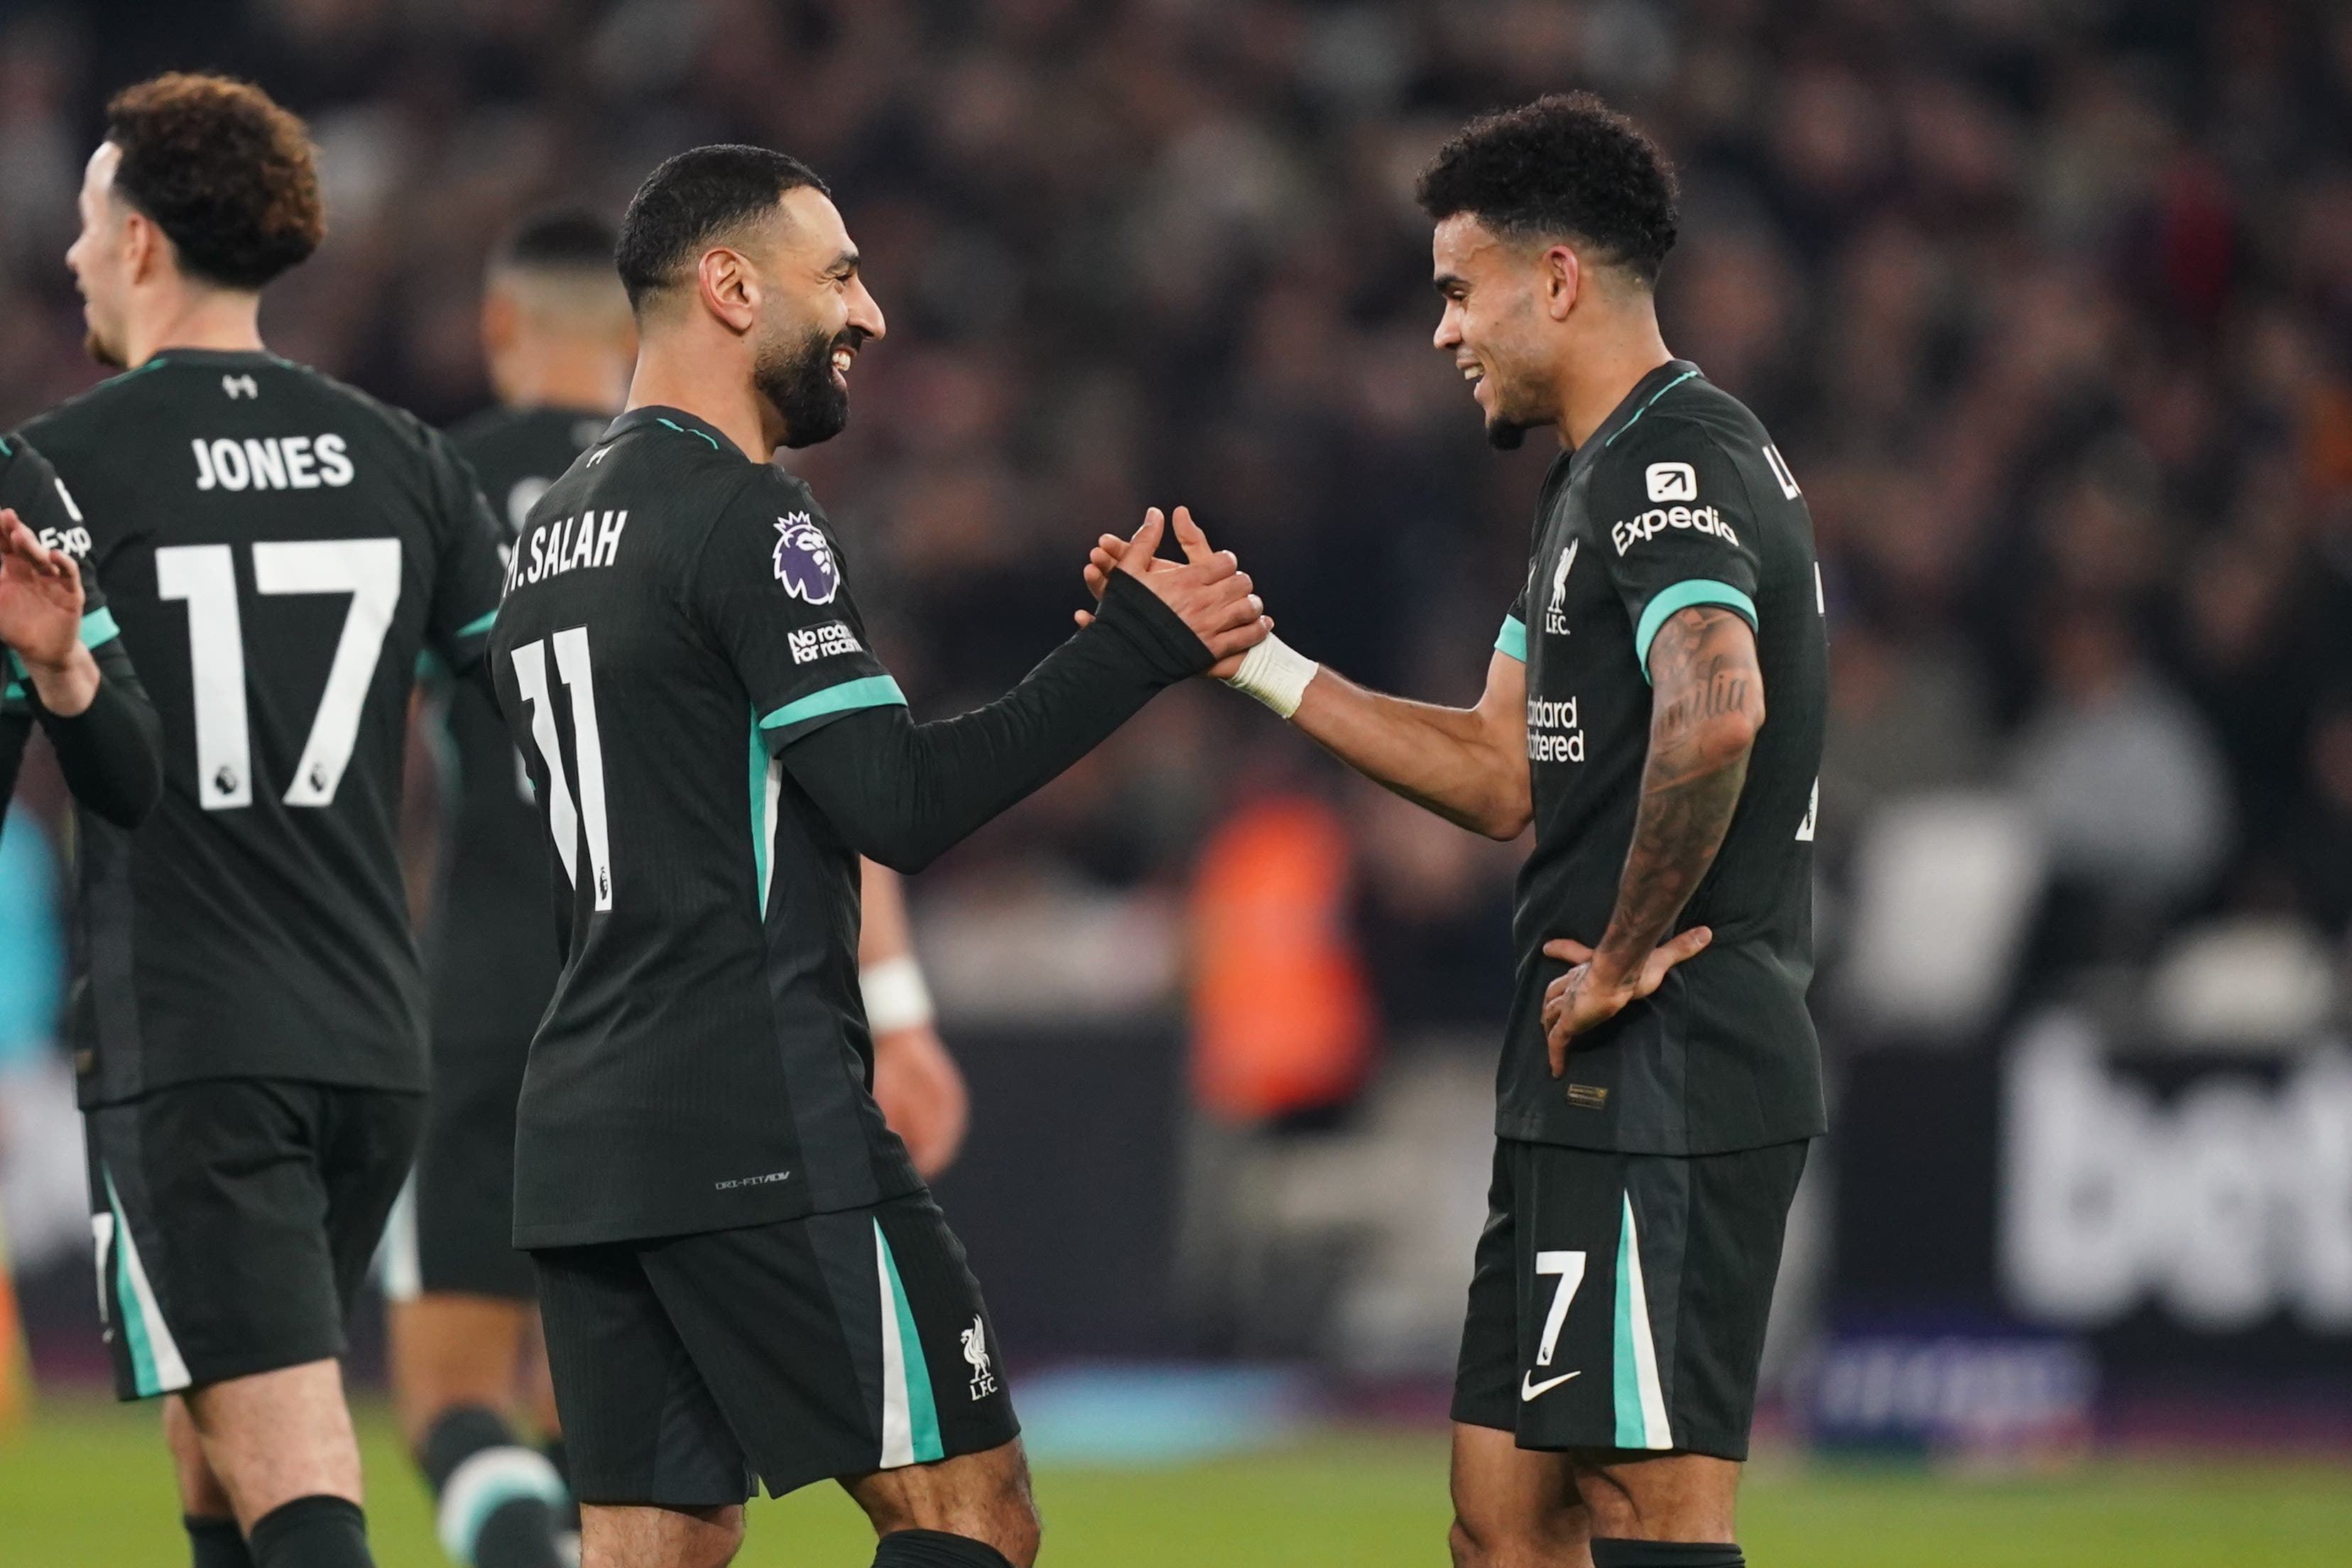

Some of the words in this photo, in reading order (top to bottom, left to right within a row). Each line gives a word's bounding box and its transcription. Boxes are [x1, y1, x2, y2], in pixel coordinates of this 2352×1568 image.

[191, 434, 354, 491] JONES
[1611, 506, 1739, 557] Expedia
[788, 629, 817, 649] No
[793, 644, 819, 665] for
[155, 538, 402, 811] 17
[511, 626, 611, 912] 11
[1536, 1251, 1586, 1366] 7
